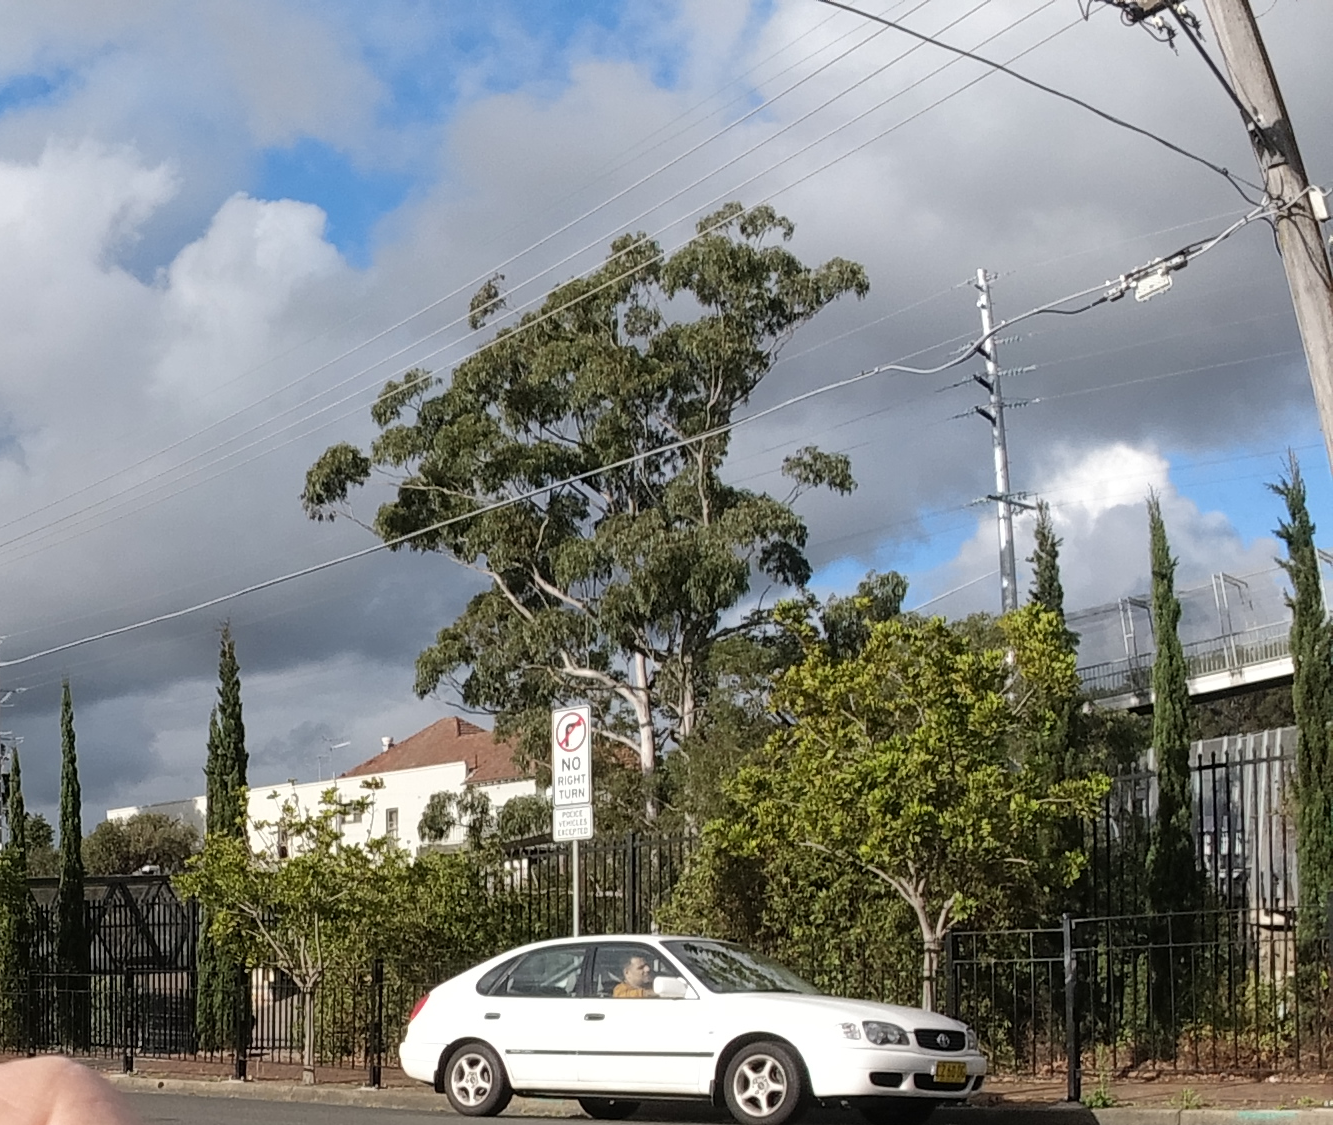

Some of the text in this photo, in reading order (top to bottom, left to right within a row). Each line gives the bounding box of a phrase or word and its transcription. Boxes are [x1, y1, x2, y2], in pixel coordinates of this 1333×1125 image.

[561, 756, 581, 772] NO
[557, 773, 586, 787] RIGHT
[558, 788, 585, 800] TURN
[562, 809, 583, 819] POLICE
[558, 818, 588, 828] VEHICLES
[558, 827, 589, 837] EXCEPTED
